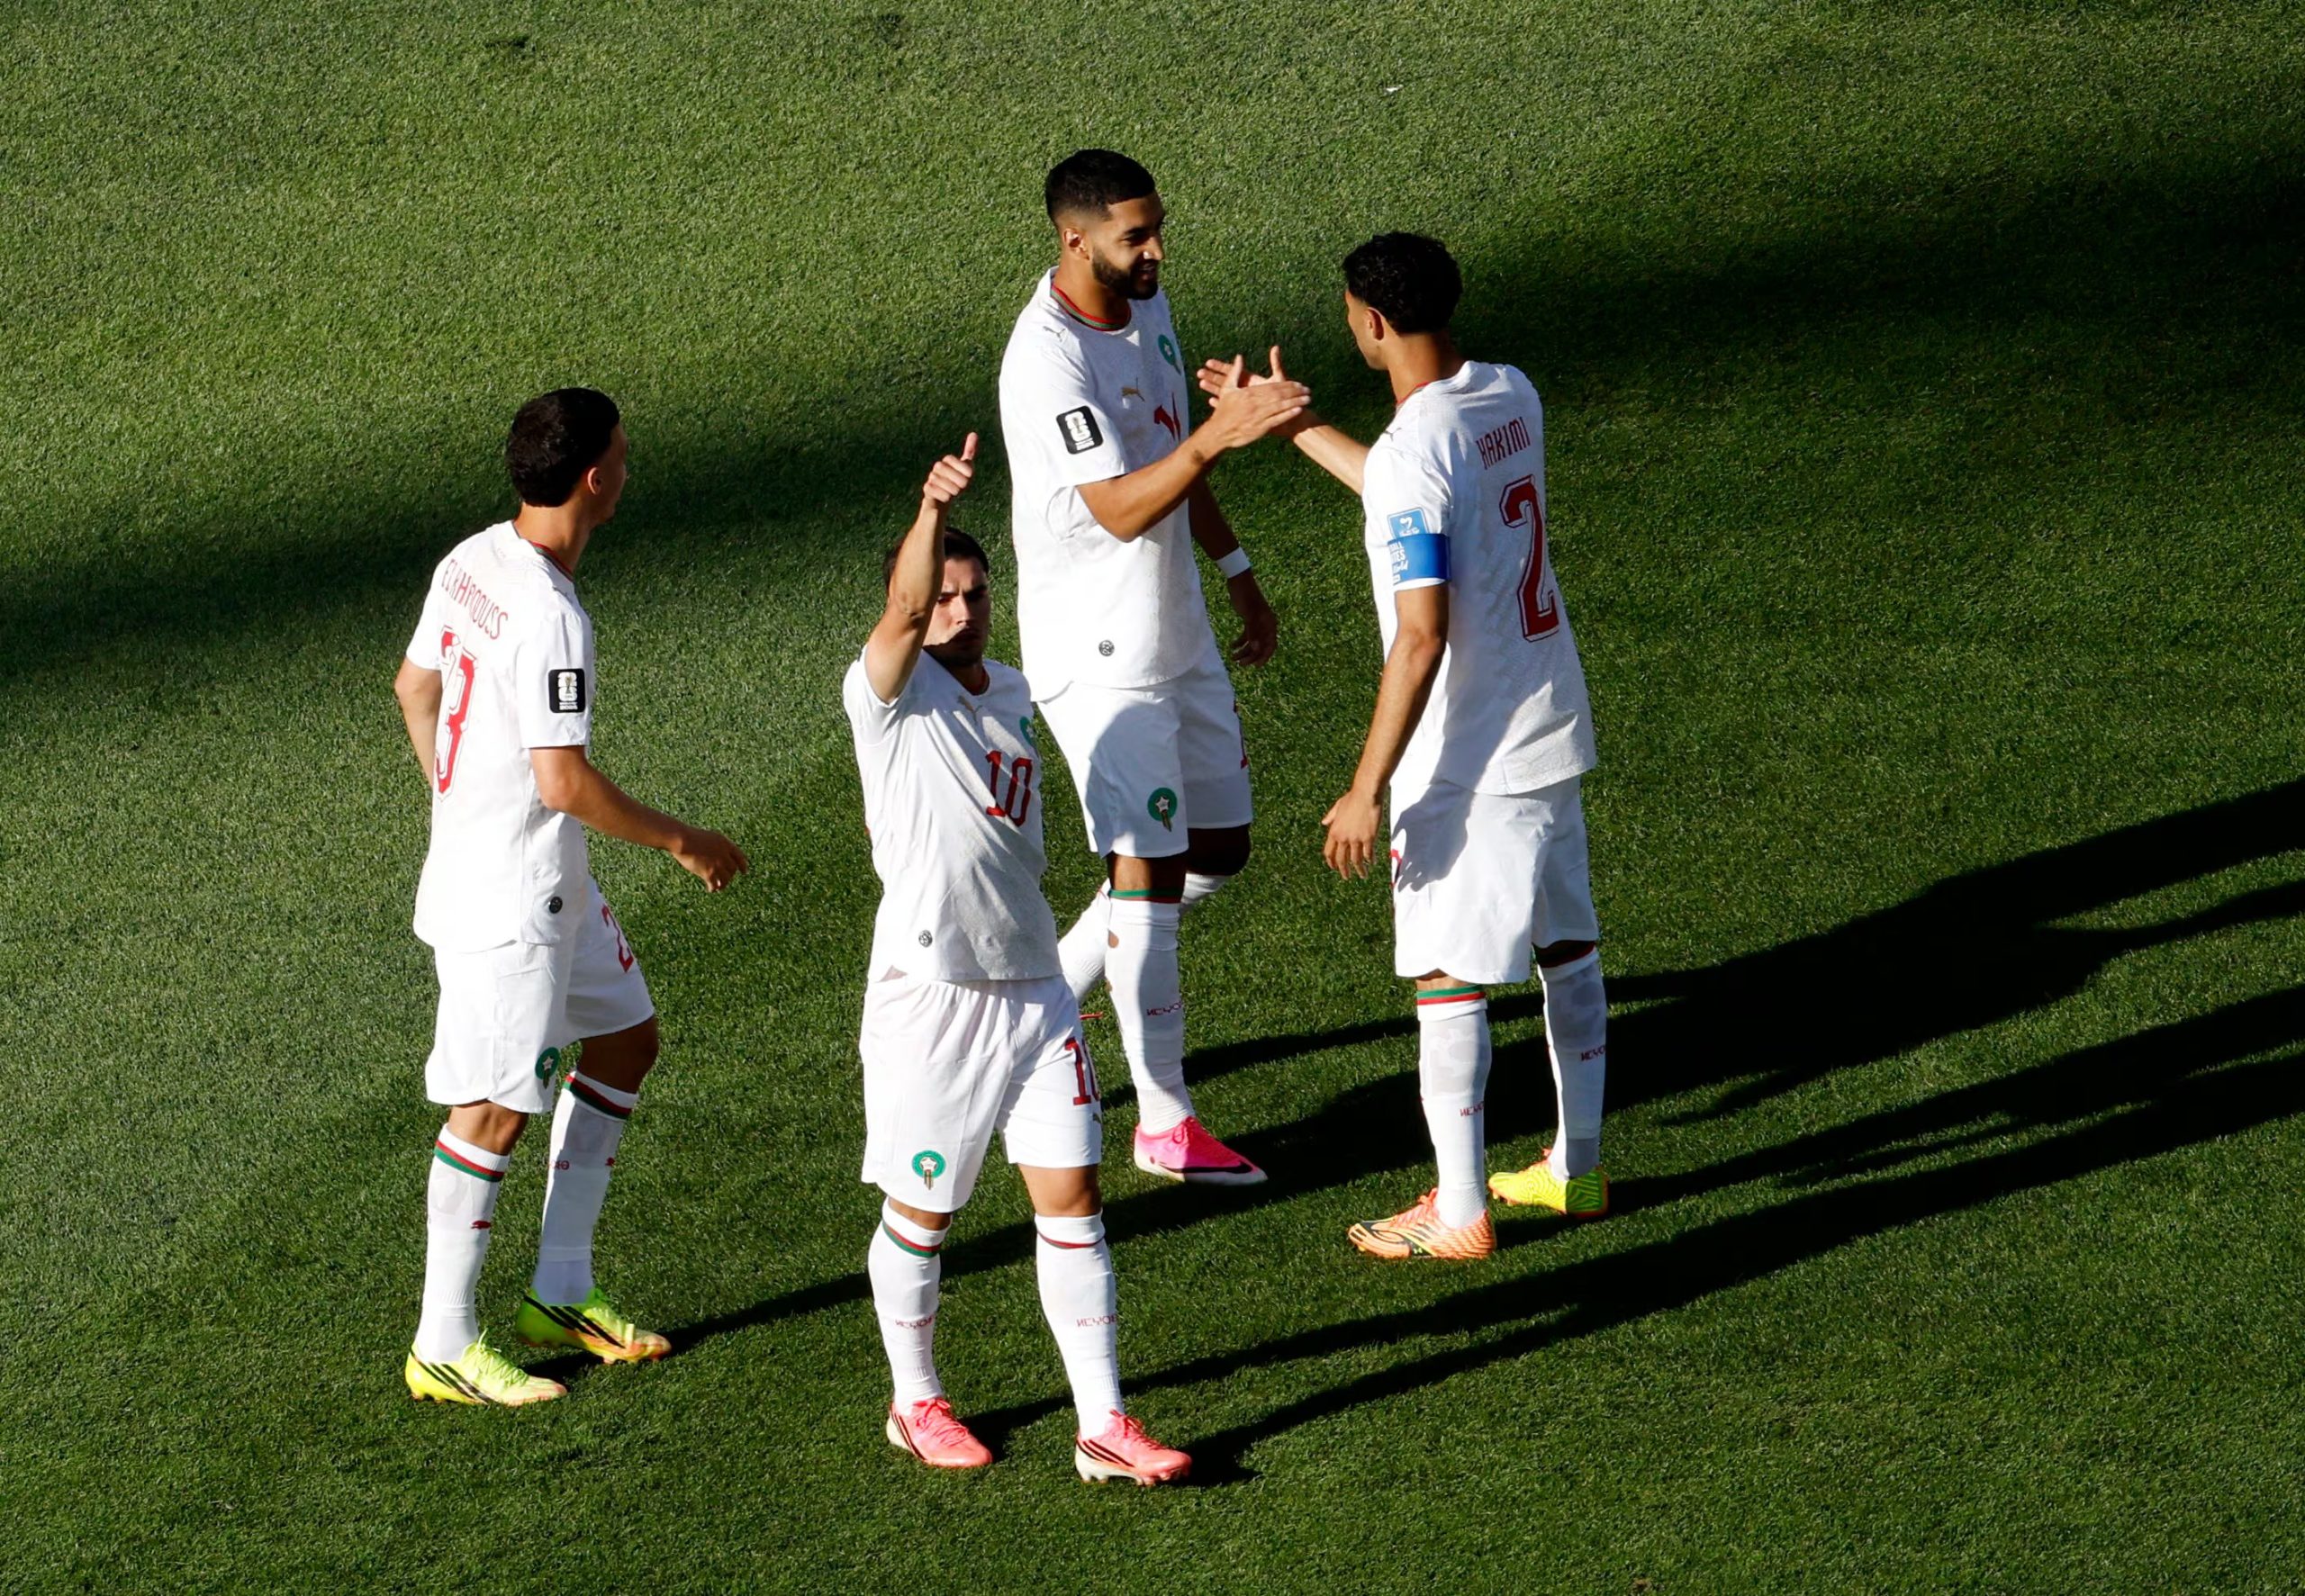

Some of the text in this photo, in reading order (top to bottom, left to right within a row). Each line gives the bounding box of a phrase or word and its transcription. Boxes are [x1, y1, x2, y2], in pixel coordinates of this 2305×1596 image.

[1476, 416, 1531, 470] HAKIMI
[1499, 473, 1560, 642] 2
[986, 749, 1033, 826] 10
